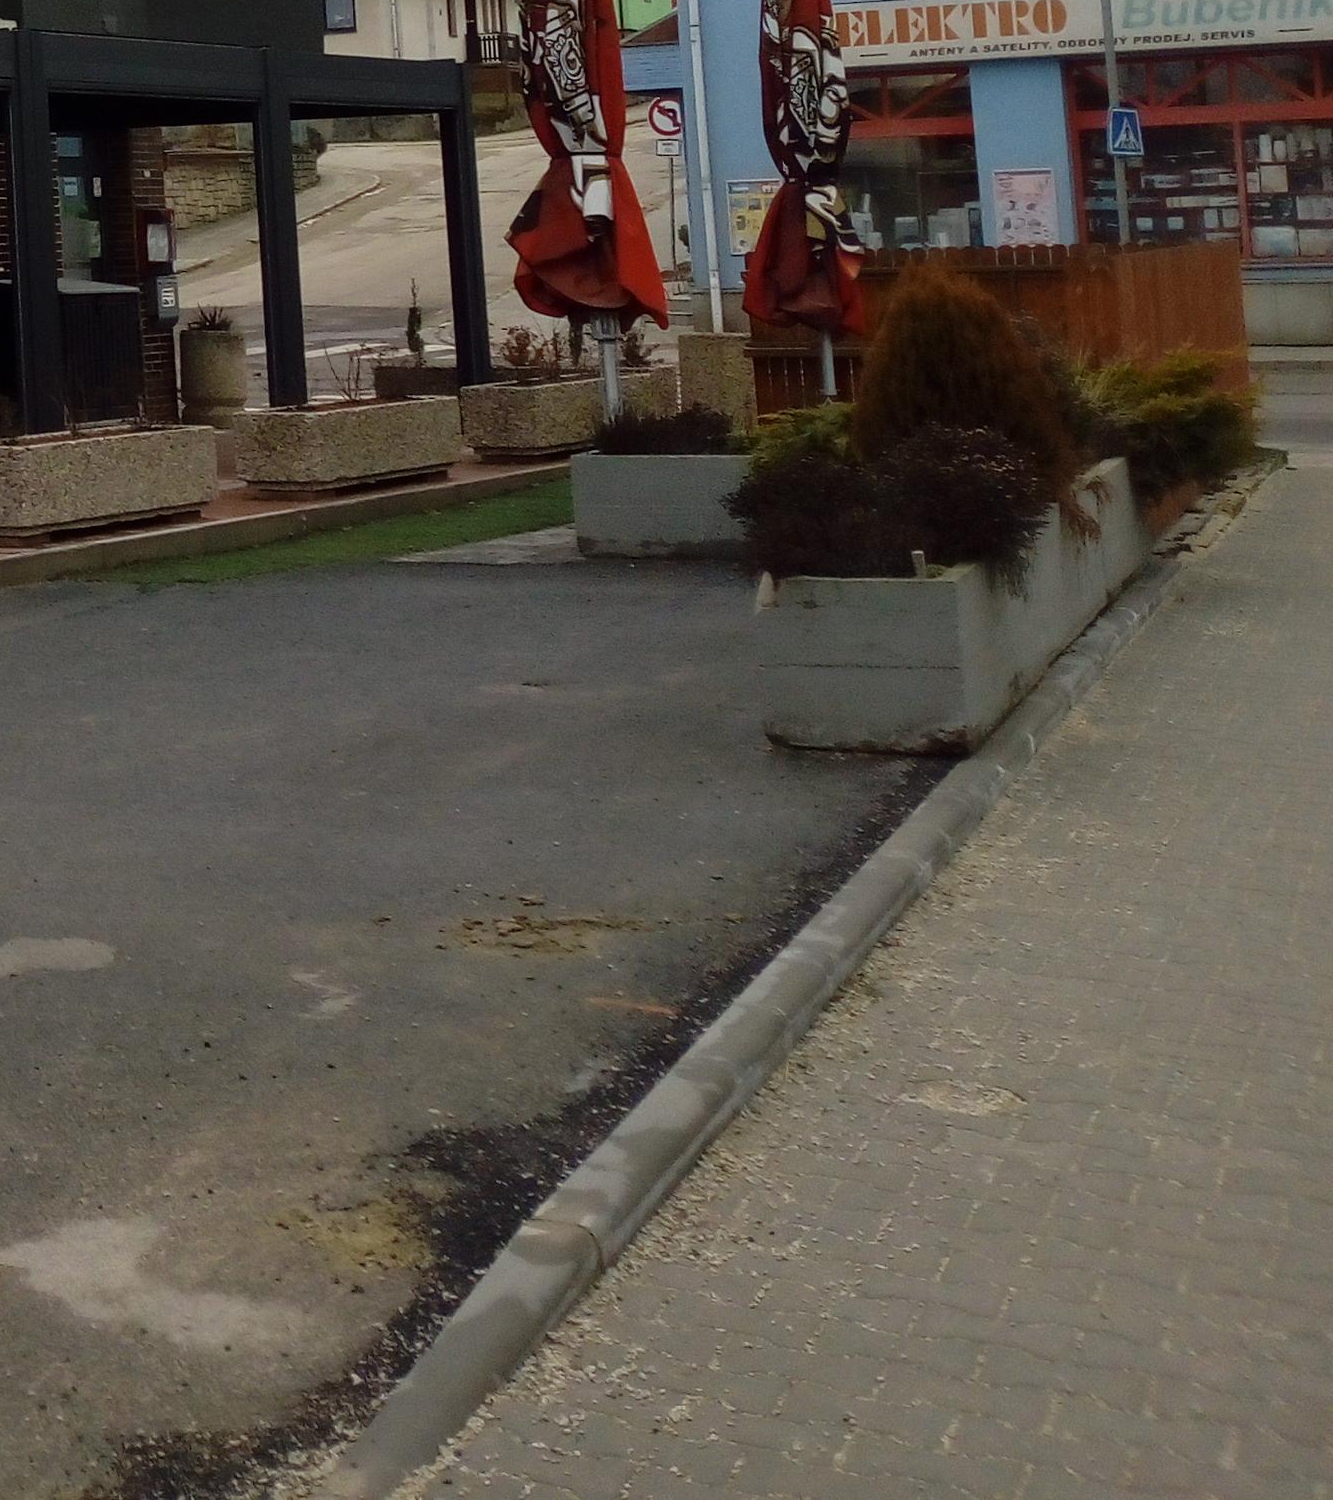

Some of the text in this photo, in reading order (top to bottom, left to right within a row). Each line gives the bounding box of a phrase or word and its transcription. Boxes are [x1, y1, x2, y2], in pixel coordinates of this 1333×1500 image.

[909, 47, 965, 58] ANTENY
[970, 45, 979, 55] A
[1201, 29, 1255, 41] SERVIS
